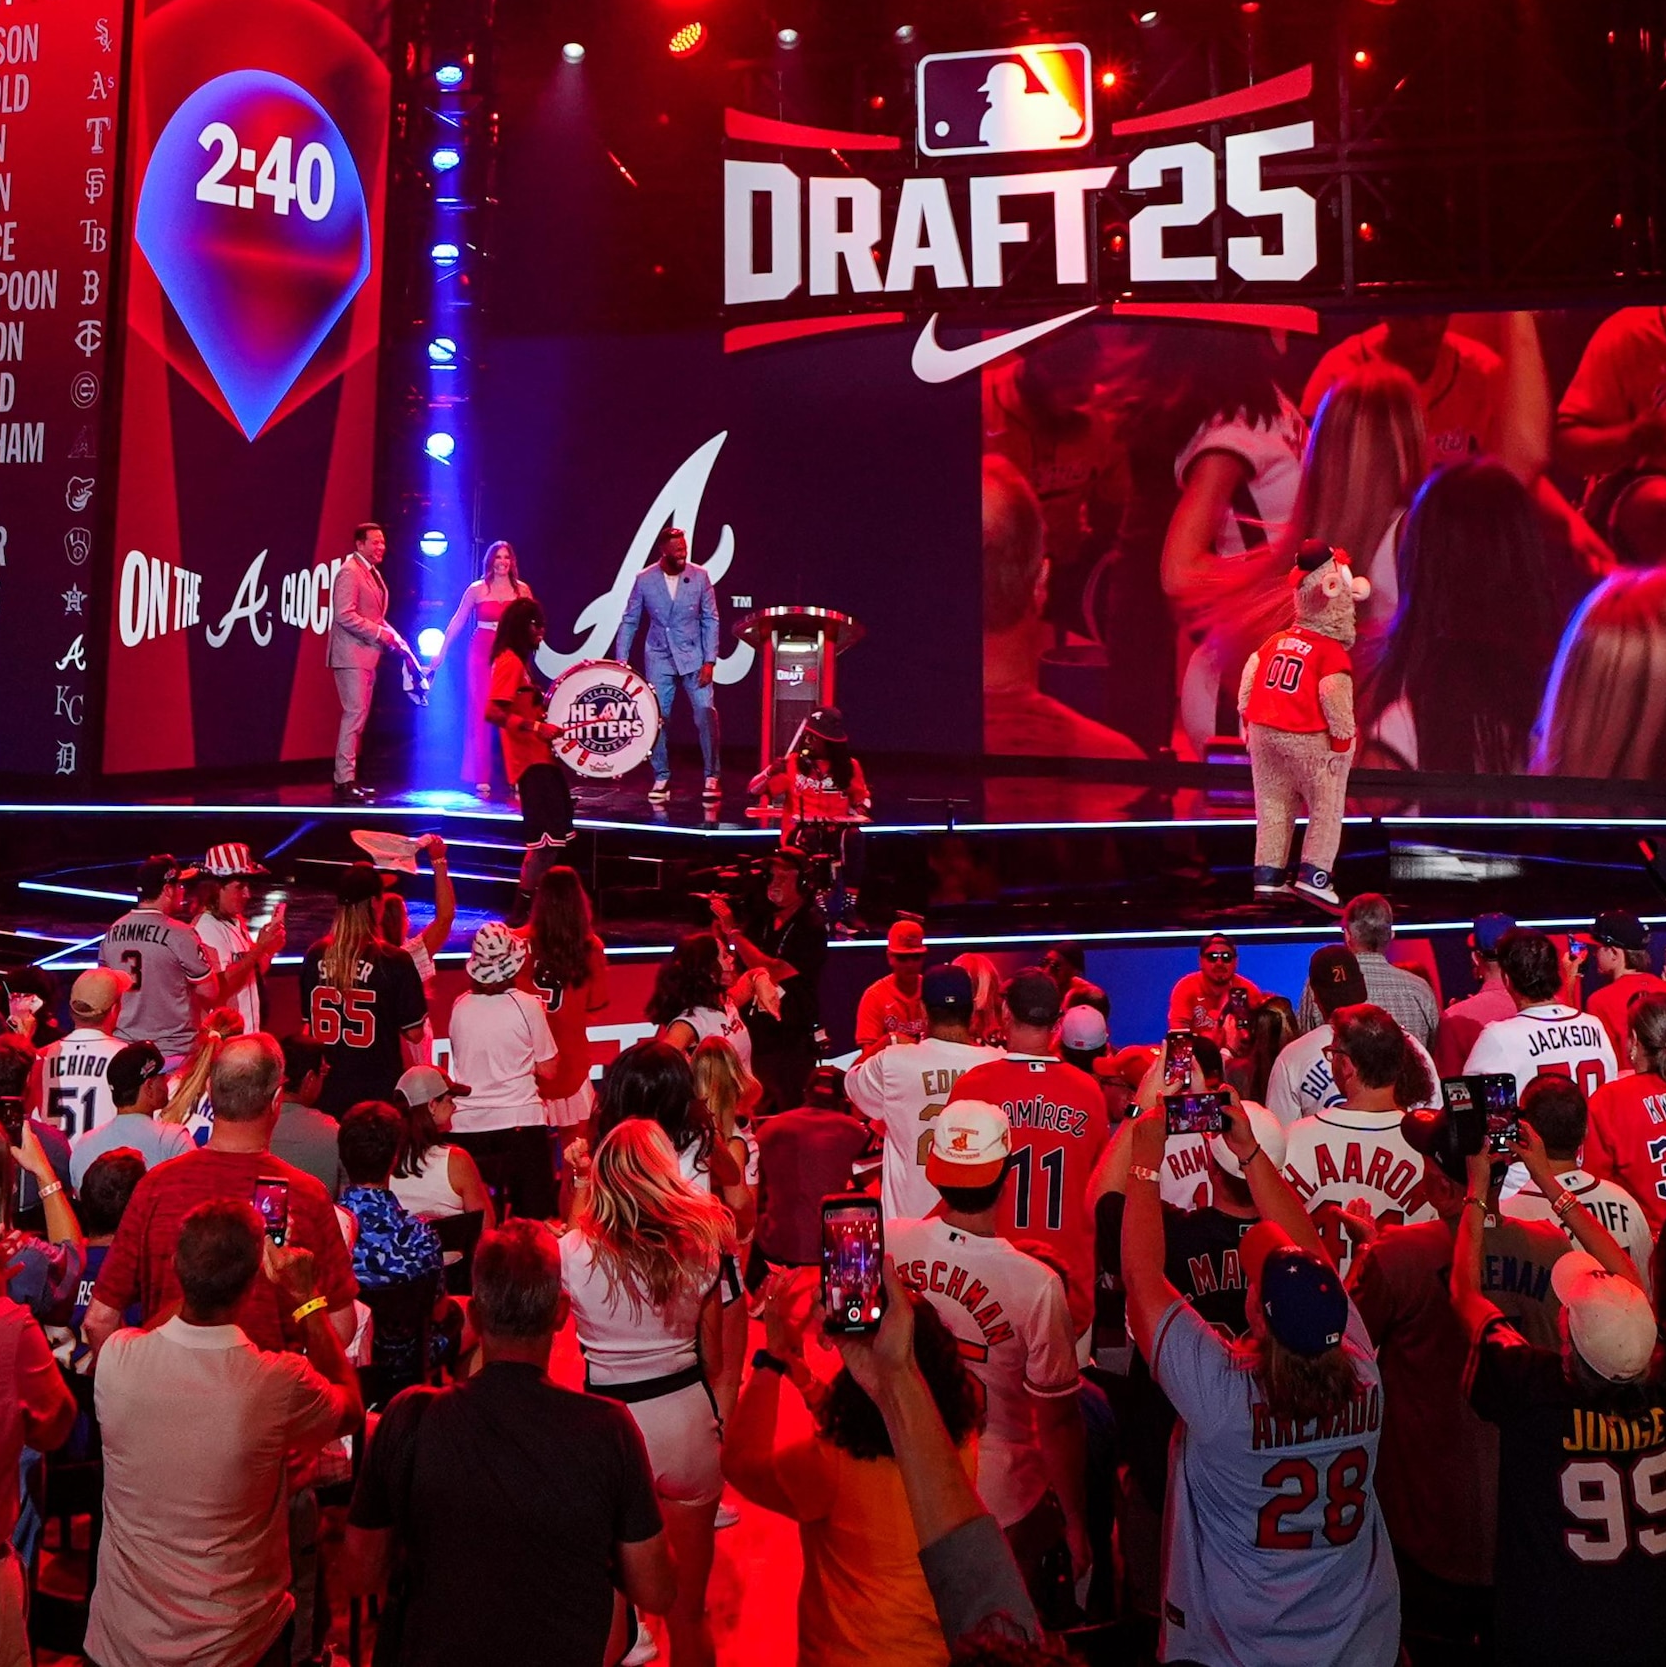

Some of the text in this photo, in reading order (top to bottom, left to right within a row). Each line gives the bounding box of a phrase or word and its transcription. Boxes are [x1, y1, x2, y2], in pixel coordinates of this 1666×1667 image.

[195, 121, 335, 222] 2:40
[724, 120, 1319, 306] DRAFT 25
[119, 550, 169, 648] ON
[173, 559, 202, 632] THE
[730, 596, 752, 609] TM
[582, 685, 625, 704] ATLANTA
[1265, 654, 1304, 695] 00
[563, 720, 644, 741] HITTERS
[569, 700, 638, 724] HEAVY
[105, 923, 171, 947] TRAMMELL
[120, 949, 143, 992] 3
[1332, 965, 1348, 983] 21
[310, 985, 377, 1049] 65
[1528, 1025, 1602, 1057] JACKSON
[50, 1054, 108, 1079] ICHIRO
[47, 1086, 98, 1141] 51
[1002, 1095, 1088, 1138] AMÍREZ
[1009, 1143, 1066, 1232] 11
[1256, 1446, 1371, 1551] 28
